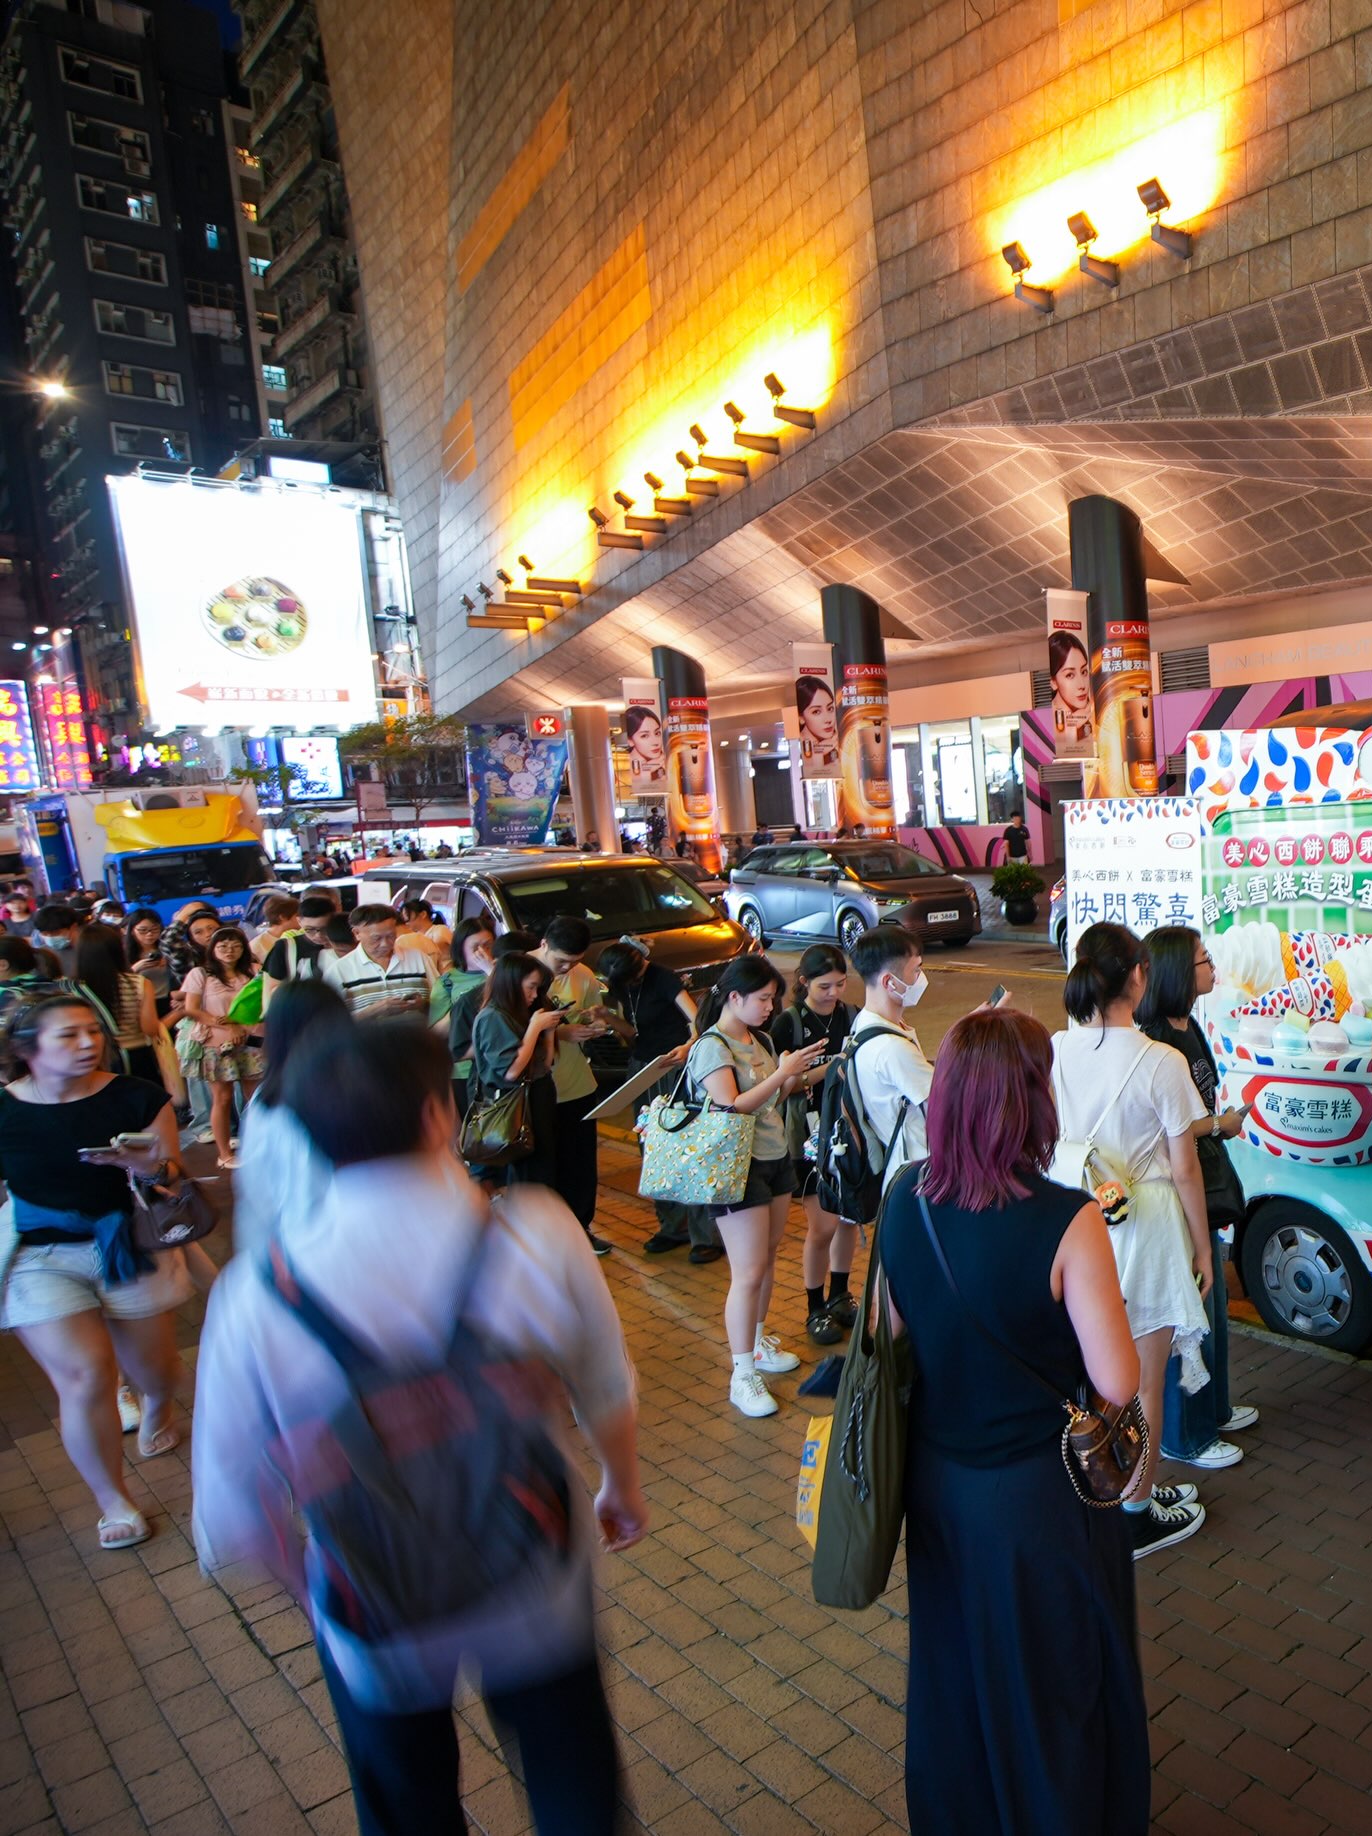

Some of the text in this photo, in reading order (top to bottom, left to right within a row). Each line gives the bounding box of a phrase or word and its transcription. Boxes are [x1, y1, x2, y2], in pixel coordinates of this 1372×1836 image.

[1102, 647, 1123, 659] 全新
[841, 686, 857, 696] 全新
[1072, 869, 1120, 882] 美心西餅
[1140, 869, 1194, 882] 富豪雪糕
[1072, 892, 1194, 928] 快閃驚喜
[1264, 1092, 1352, 1121] 富豪雪糕
[1314, 1125, 1333, 1134] cakes
